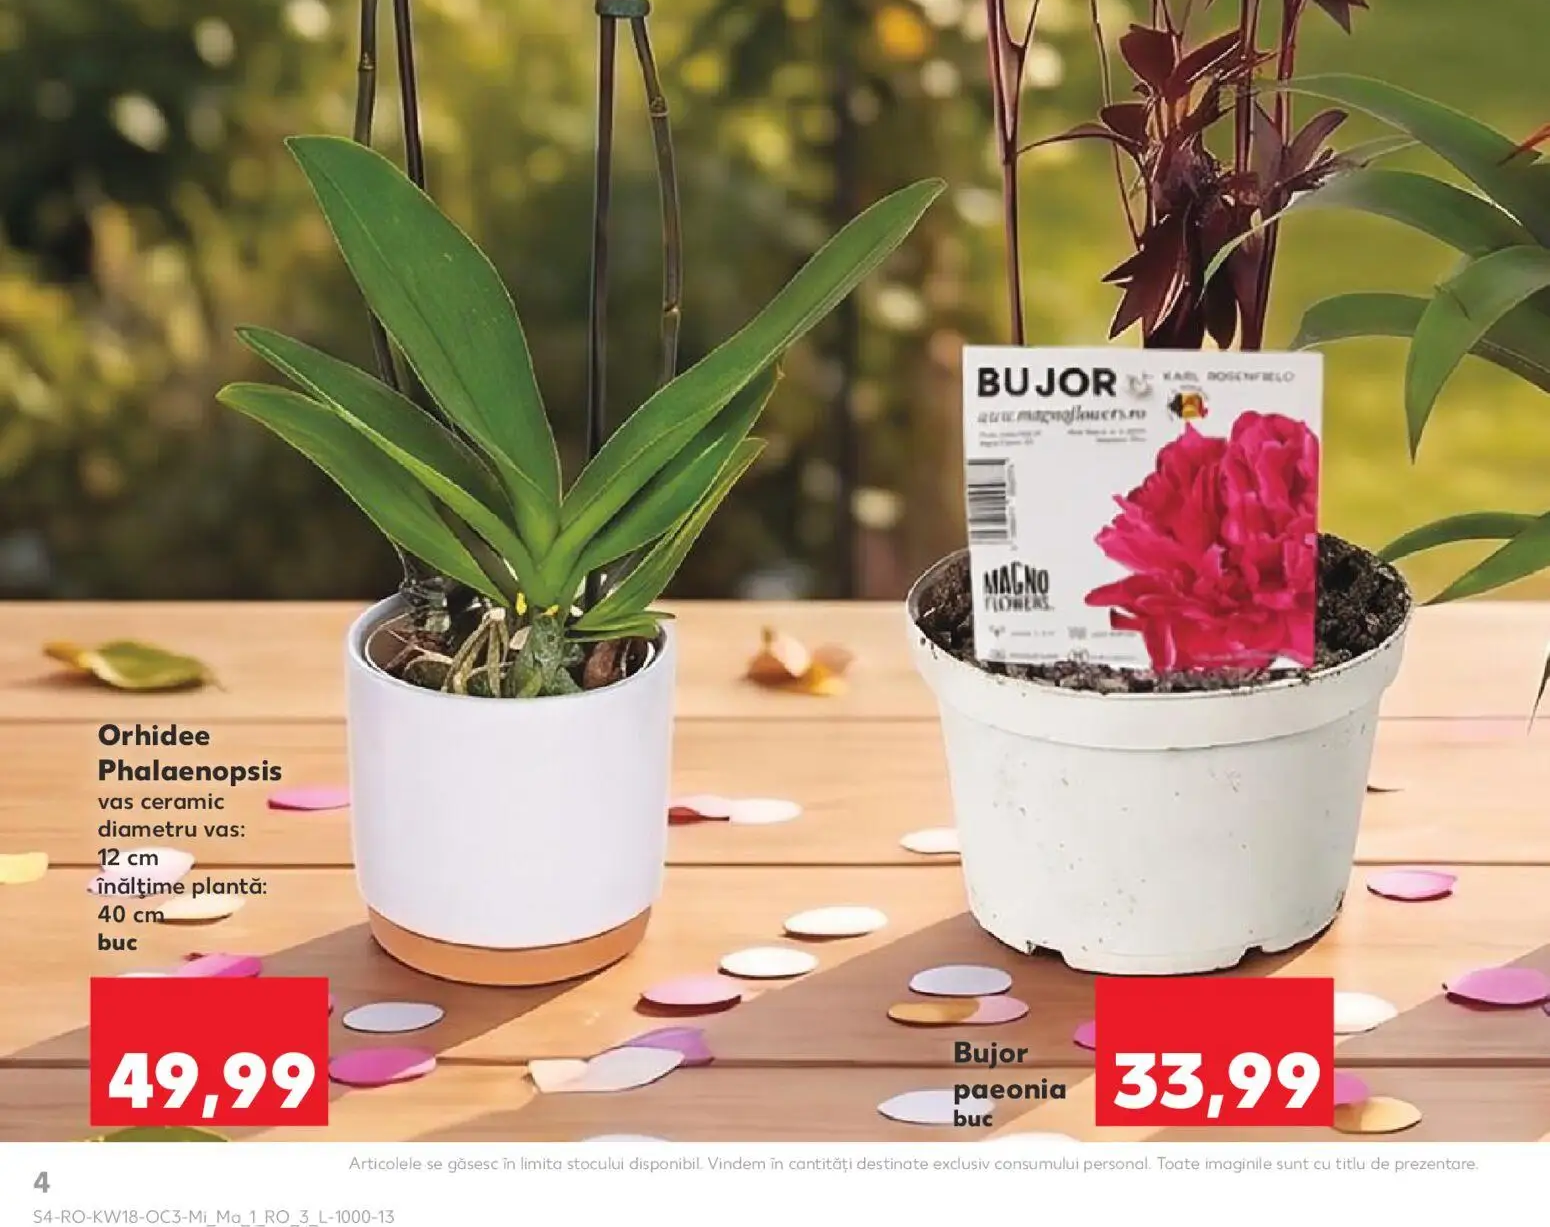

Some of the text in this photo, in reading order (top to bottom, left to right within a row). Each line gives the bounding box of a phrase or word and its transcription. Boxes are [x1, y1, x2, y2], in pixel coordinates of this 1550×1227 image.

[977, 367, 1117, 397] BUJOR
[983, 560, 1049, 595] MAGNO
[109, 1052, 316, 1118] 49,99
[1114, 1052, 1321, 1118] 33,99
